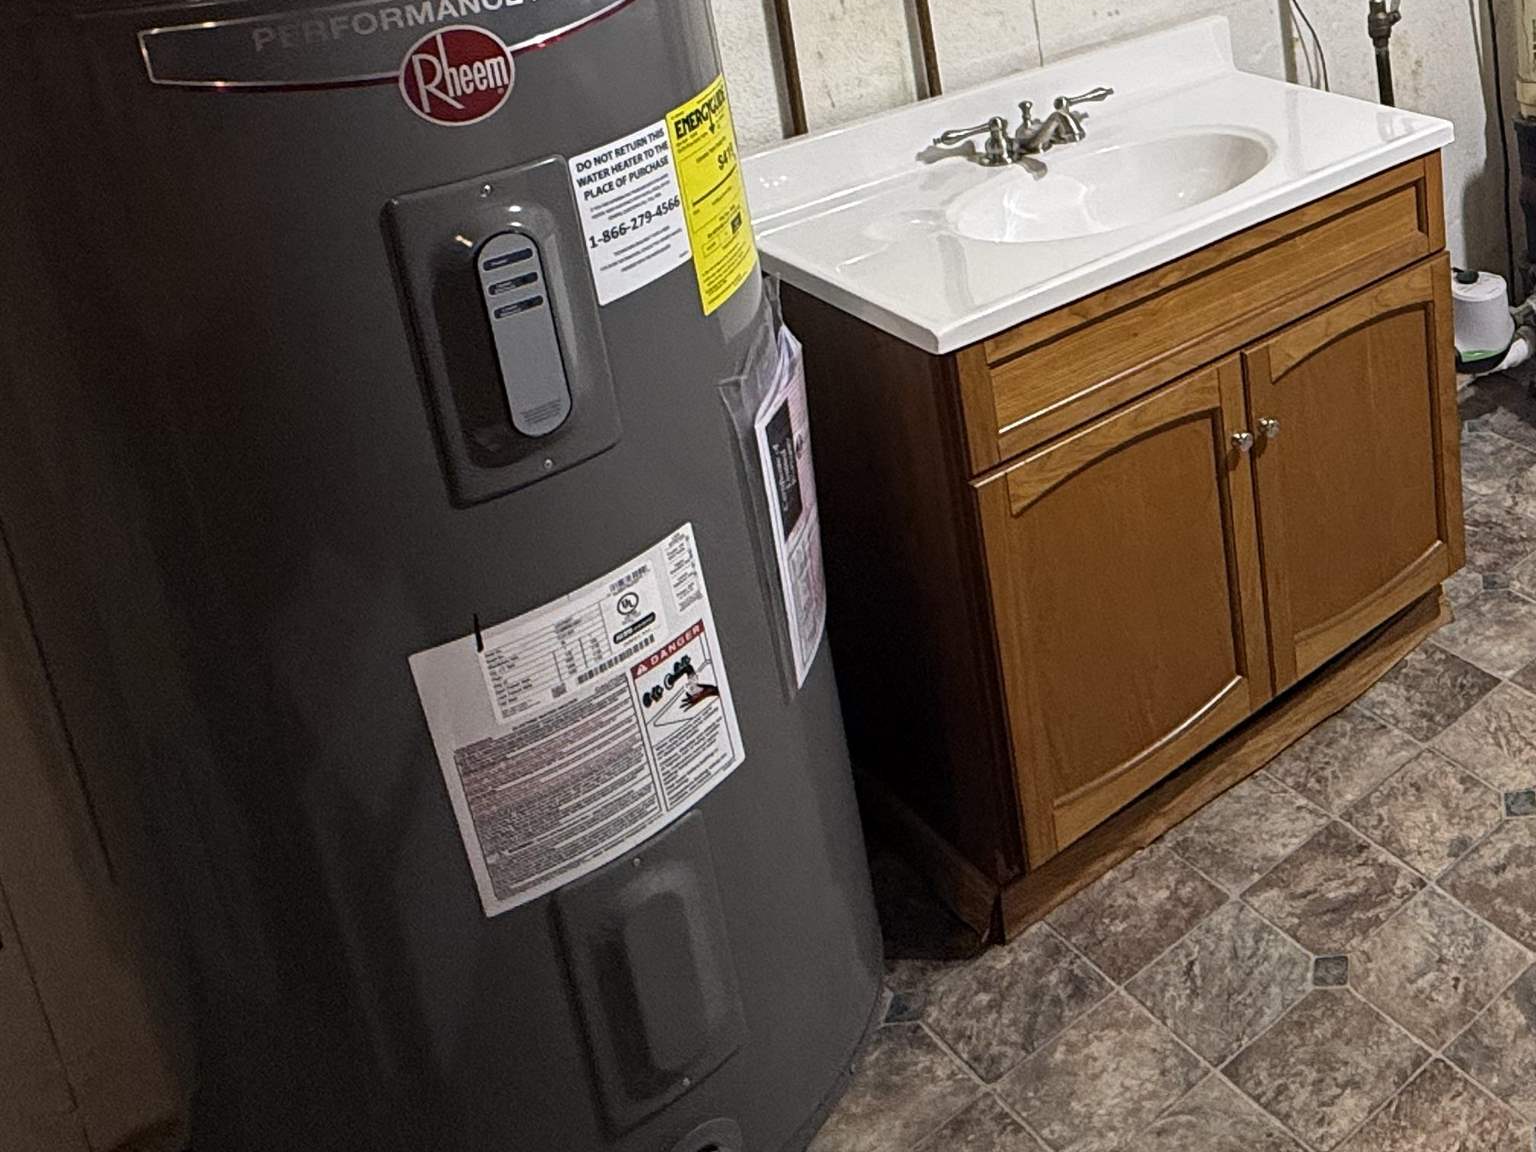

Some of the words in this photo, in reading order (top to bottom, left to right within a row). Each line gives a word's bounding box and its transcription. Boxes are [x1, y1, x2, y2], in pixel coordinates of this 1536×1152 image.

[411, 33, 509, 113] Rheem
[576, 160, 592, 172] DO
[593, 151, 613, 166] NOT
[614, 137, 648, 158] RETURN
[647, 128, 665, 142] THIS
[576, 168, 610, 187] WATER
[611, 153, 643, 174] HEATER
[643, 148, 654, 159] TO
[654, 140, 668, 153] THE
[583, 181, 615, 200] PLACE
[615, 175, 627, 188] OF
[628, 155, 669, 182] PURCHASE
[588, 194, 680, 248] 1-866-279-4566
[650, 625, 701, 664] DANGER
